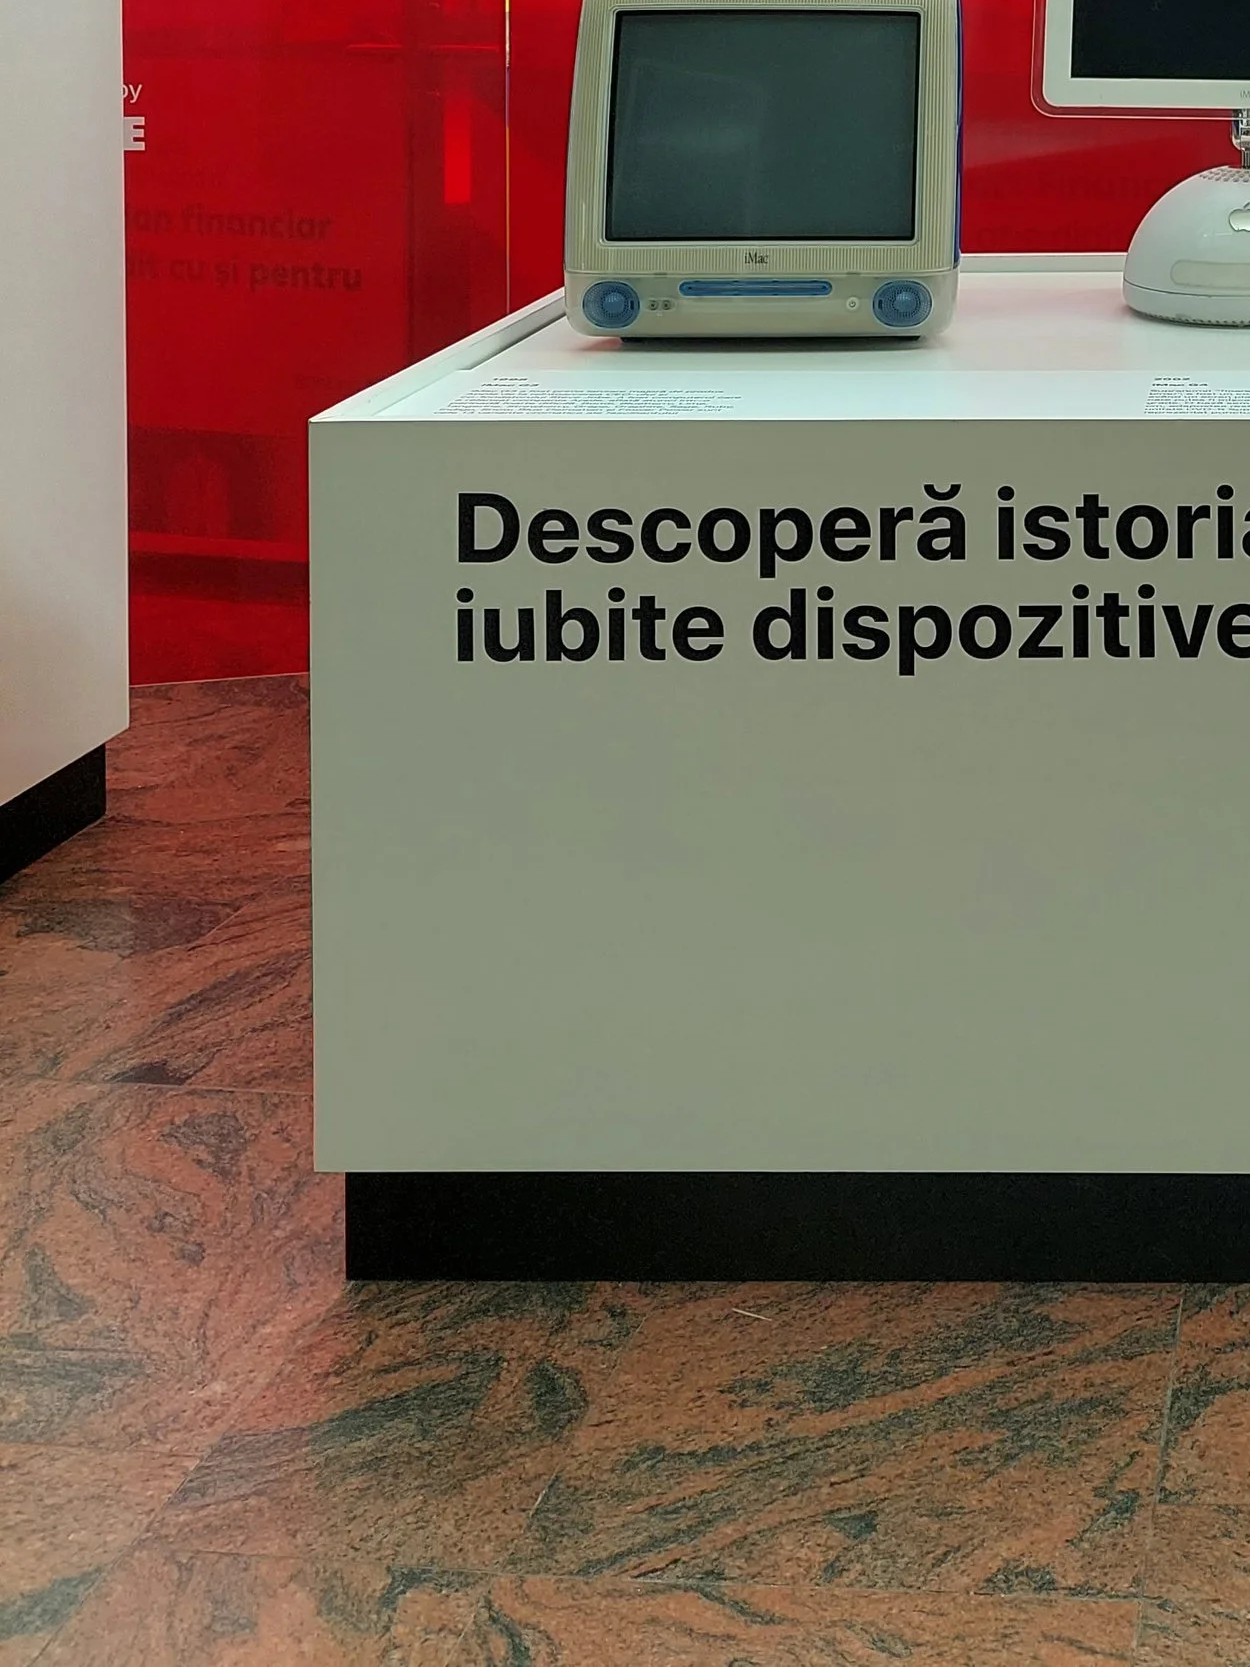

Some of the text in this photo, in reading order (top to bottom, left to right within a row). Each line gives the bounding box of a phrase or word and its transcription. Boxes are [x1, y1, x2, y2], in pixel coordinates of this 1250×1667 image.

[744, 251, 769, 265] iMac
[456, 483, 969, 578] Descoperă
[455, 587, 726, 663] iubite
